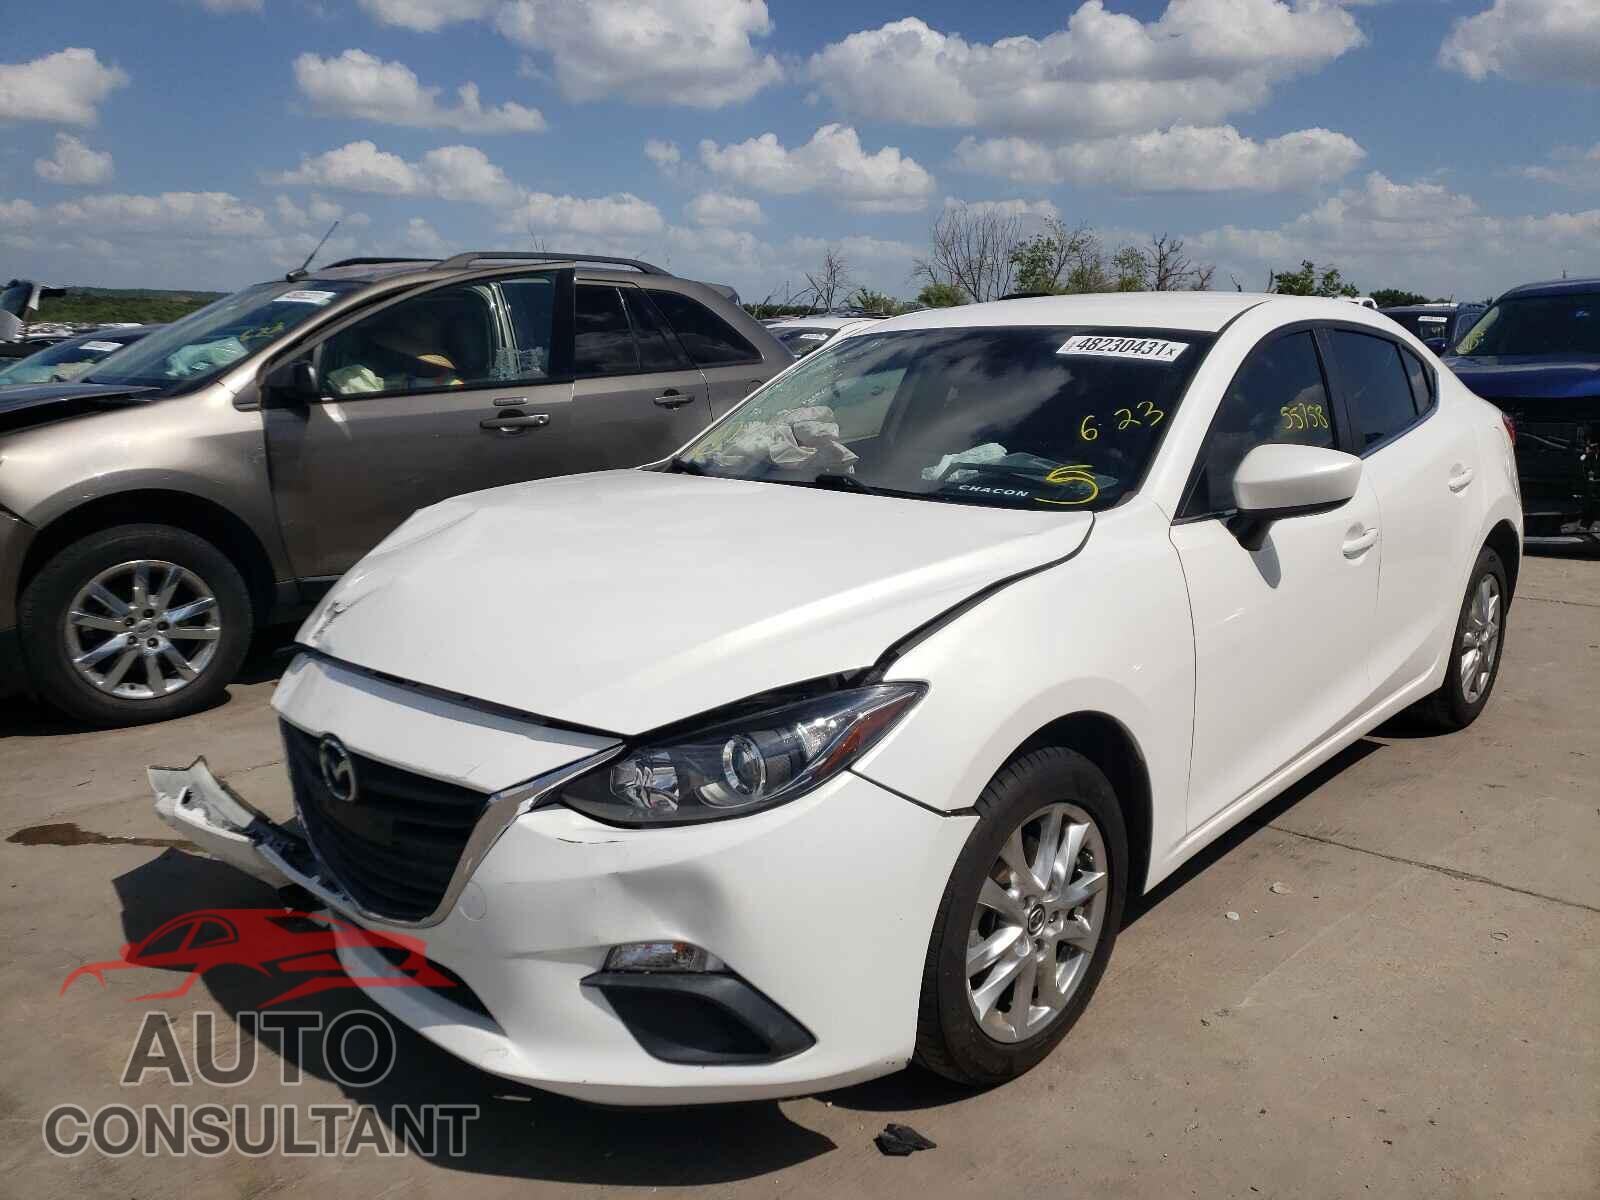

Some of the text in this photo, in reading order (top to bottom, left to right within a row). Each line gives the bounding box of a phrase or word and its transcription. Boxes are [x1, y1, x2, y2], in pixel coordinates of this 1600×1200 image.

[1076, 337, 1168, 356] 48230431
[1113, 401, 1165, 430] 23
[958, 485, 1030, 498] CHACON
